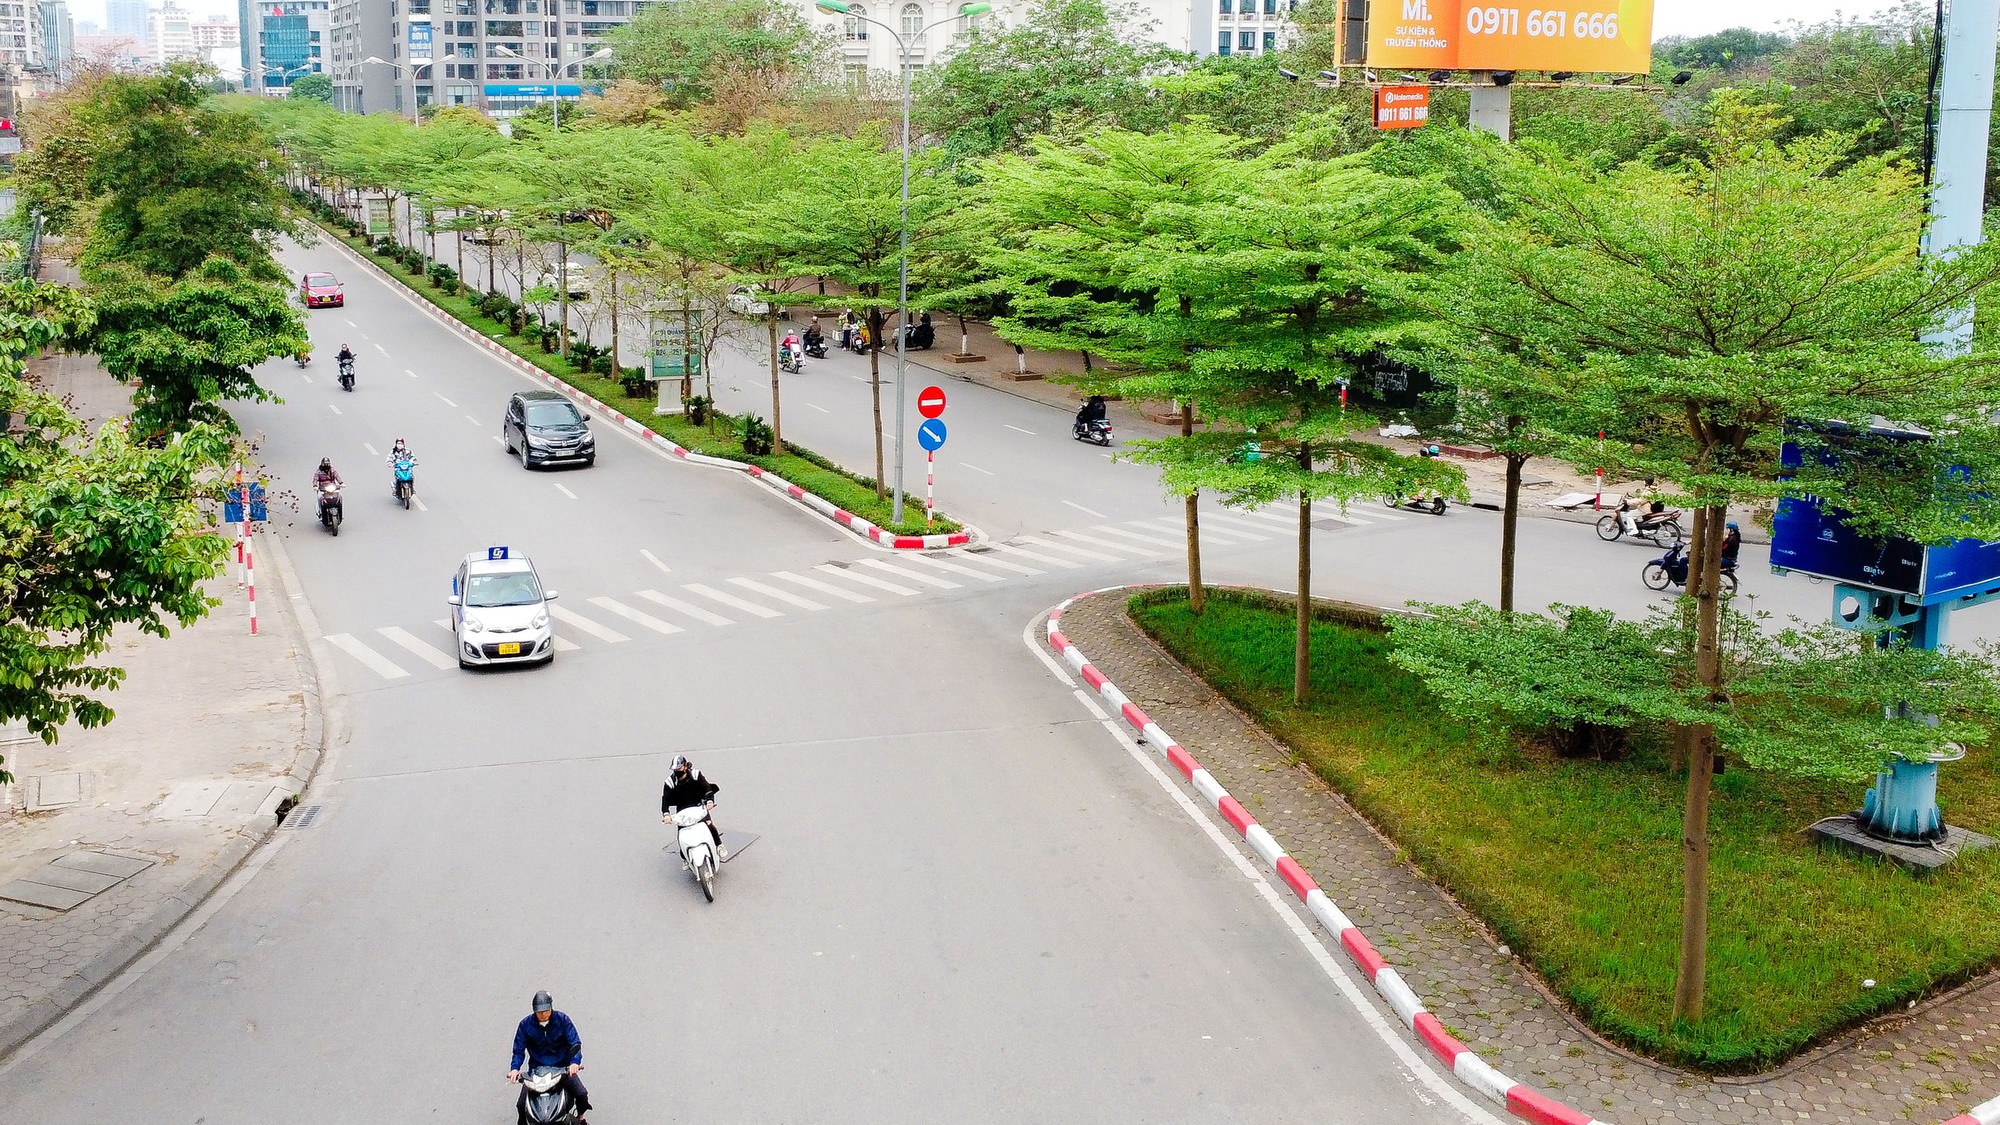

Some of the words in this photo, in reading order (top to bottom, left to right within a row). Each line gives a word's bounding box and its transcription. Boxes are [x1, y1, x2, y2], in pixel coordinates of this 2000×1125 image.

[1466, 6, 1519, 35] 0911
[1526, 9, 1567, 38] 661
[1573, 12, 1619, 39] 666
[1395, 25, 1408, 37] SỰ
[1408, 25, 1427, 37] KIỆN
[1429, 27, 1436, 36] &
[1417, 38, 1448, 48] THÔNG
[1379, 107, 1397, 122] 0911
[1399, 106, 1412, 121] 661
